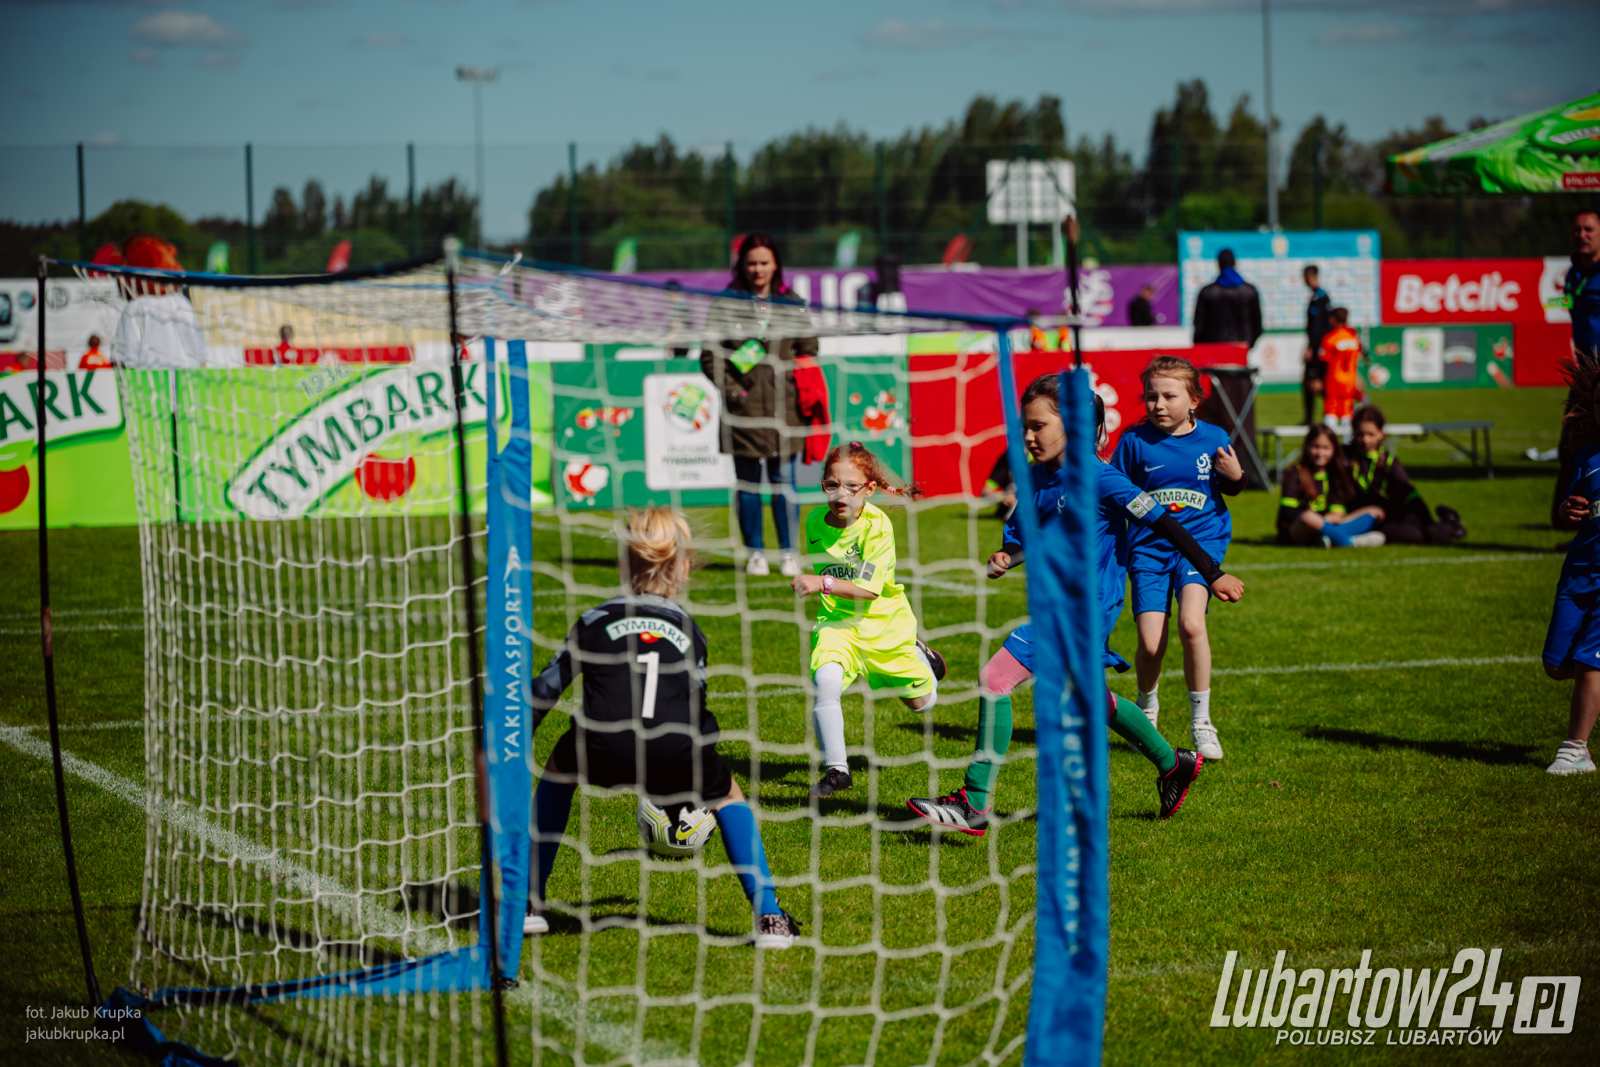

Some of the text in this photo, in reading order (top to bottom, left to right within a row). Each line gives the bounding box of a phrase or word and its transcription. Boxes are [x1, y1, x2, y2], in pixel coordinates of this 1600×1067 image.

[1394, 271, 1521, 314] Betclic
[247, 362, 487, 510] TYMBARK
[1150, 490, 1205, 506] YMBARK
[603, 619, 687, 649] TYMBARK
[504, 584, 522, 762] YAKIMASPORT
[637, 651, 659, 719] 1
